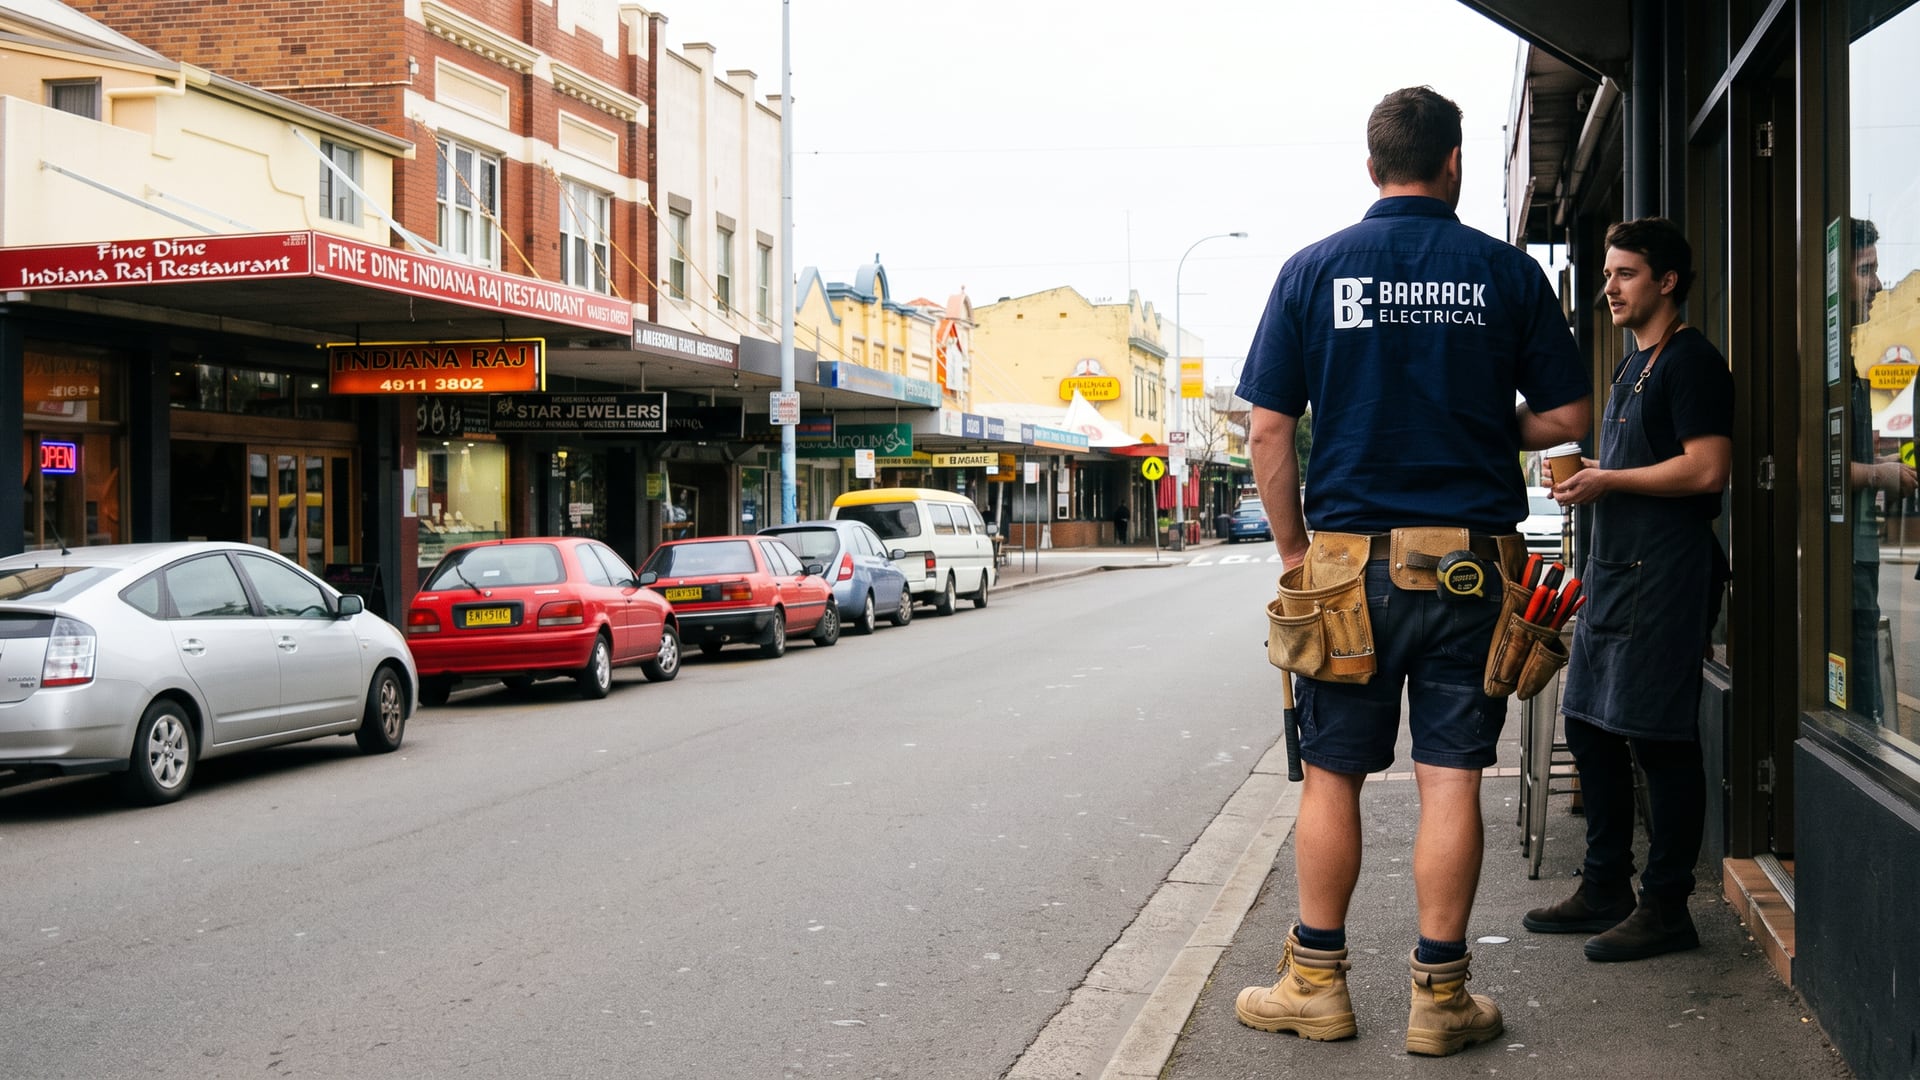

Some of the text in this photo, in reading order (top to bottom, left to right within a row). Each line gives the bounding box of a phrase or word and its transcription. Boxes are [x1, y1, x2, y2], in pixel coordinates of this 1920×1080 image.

[97, 240, 207, 261] Fine Dine
[20, 255, 291, 286] Indiana Raj Restaurant
[328, 242, 367, 274] FINE
[370, 252, 410, 283] DINE
[413, 261, 476, 297] INDIANA
[478, 276, 501, 306] RAJ
[504, 281, 585, 317] RESTAURANT
[1379, 281, 1486, 307] BARRACK
[1379, 309, 1487, 326] ELECTRICAL
[470, 346, 528, 369] RAJ
[434, 377, 484, 390] 3802
[516, 404, 661, 419] STAR JEWELERS
